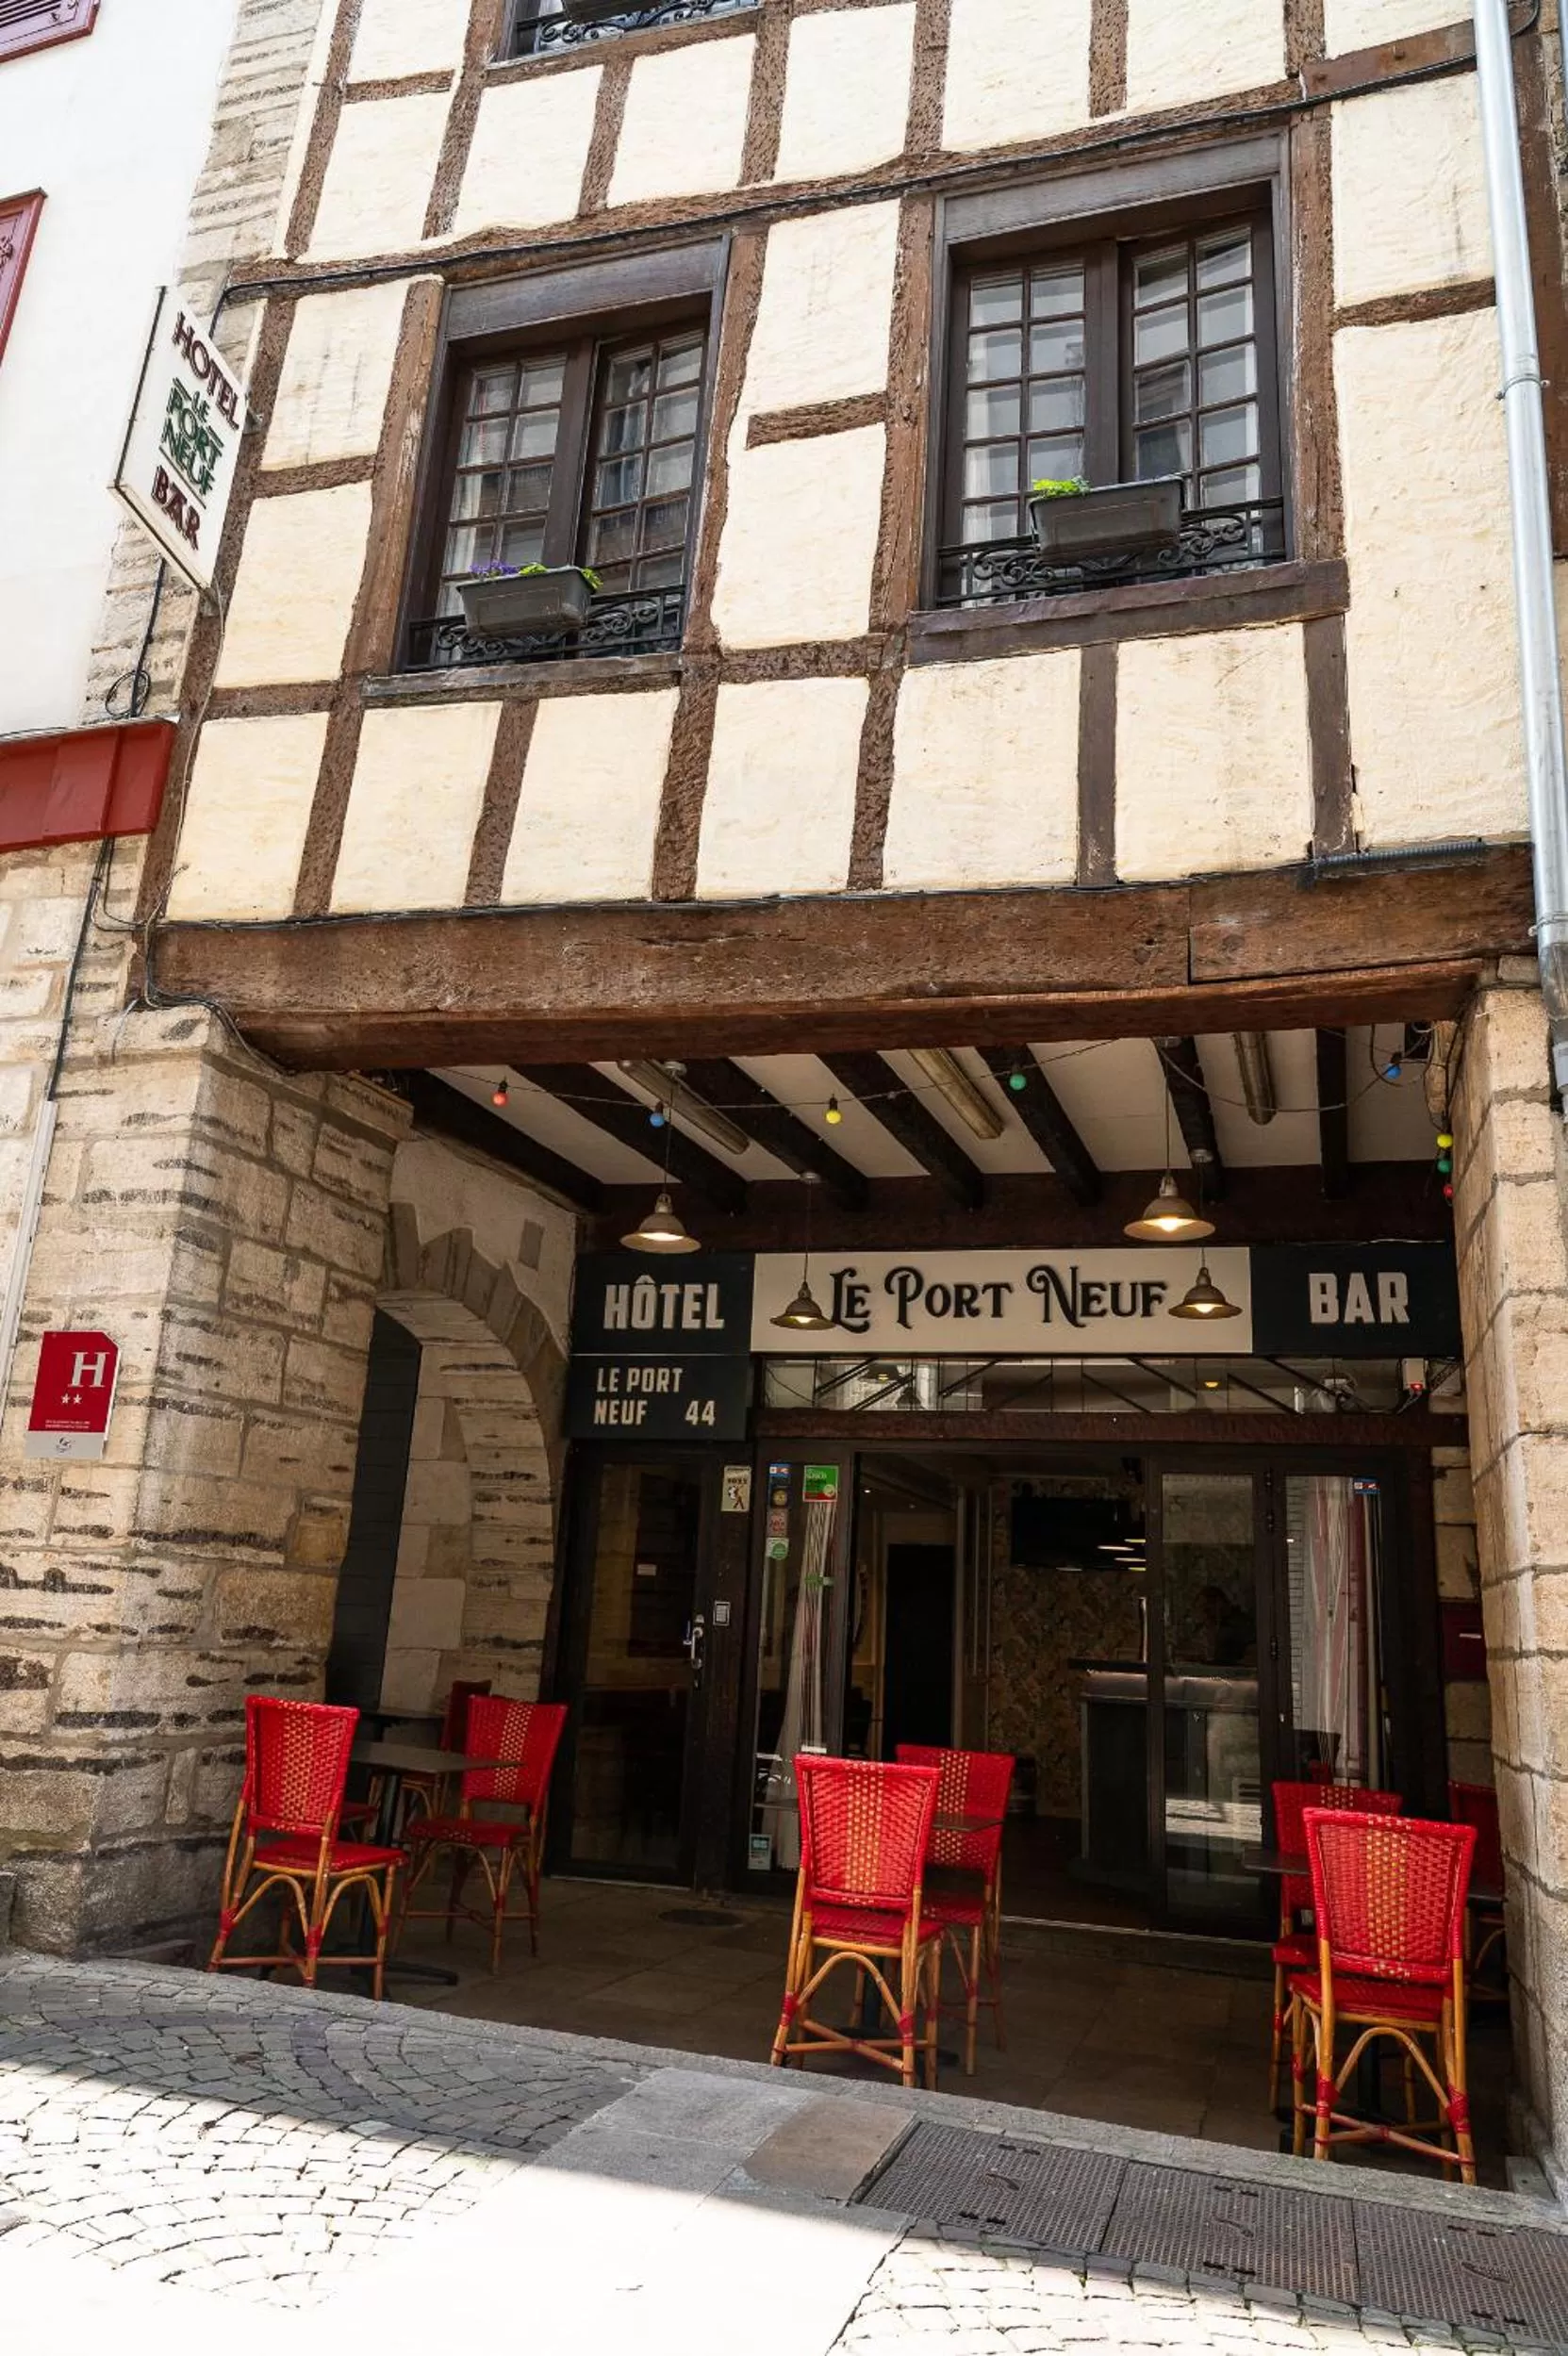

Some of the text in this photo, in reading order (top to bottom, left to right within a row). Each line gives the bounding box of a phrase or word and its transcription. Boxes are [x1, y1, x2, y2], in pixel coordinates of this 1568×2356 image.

[172, 311, 239, 430] HOTEL
[166, 387, 223, 470] PORT
[191, 390, 209, 422] LE
[161, 418, 215, 496] NEUF
[151, 465, 200, 551] BAR
[603, 1275, 725, 1330] HÔTEL
[1308, 1272, 1411, 1324] BAR
[67, 1351, 110, 1388] H
[597, 1367, 684, 1393] LE PORT
[593, 1400, 716, 1426] NEUF 44
